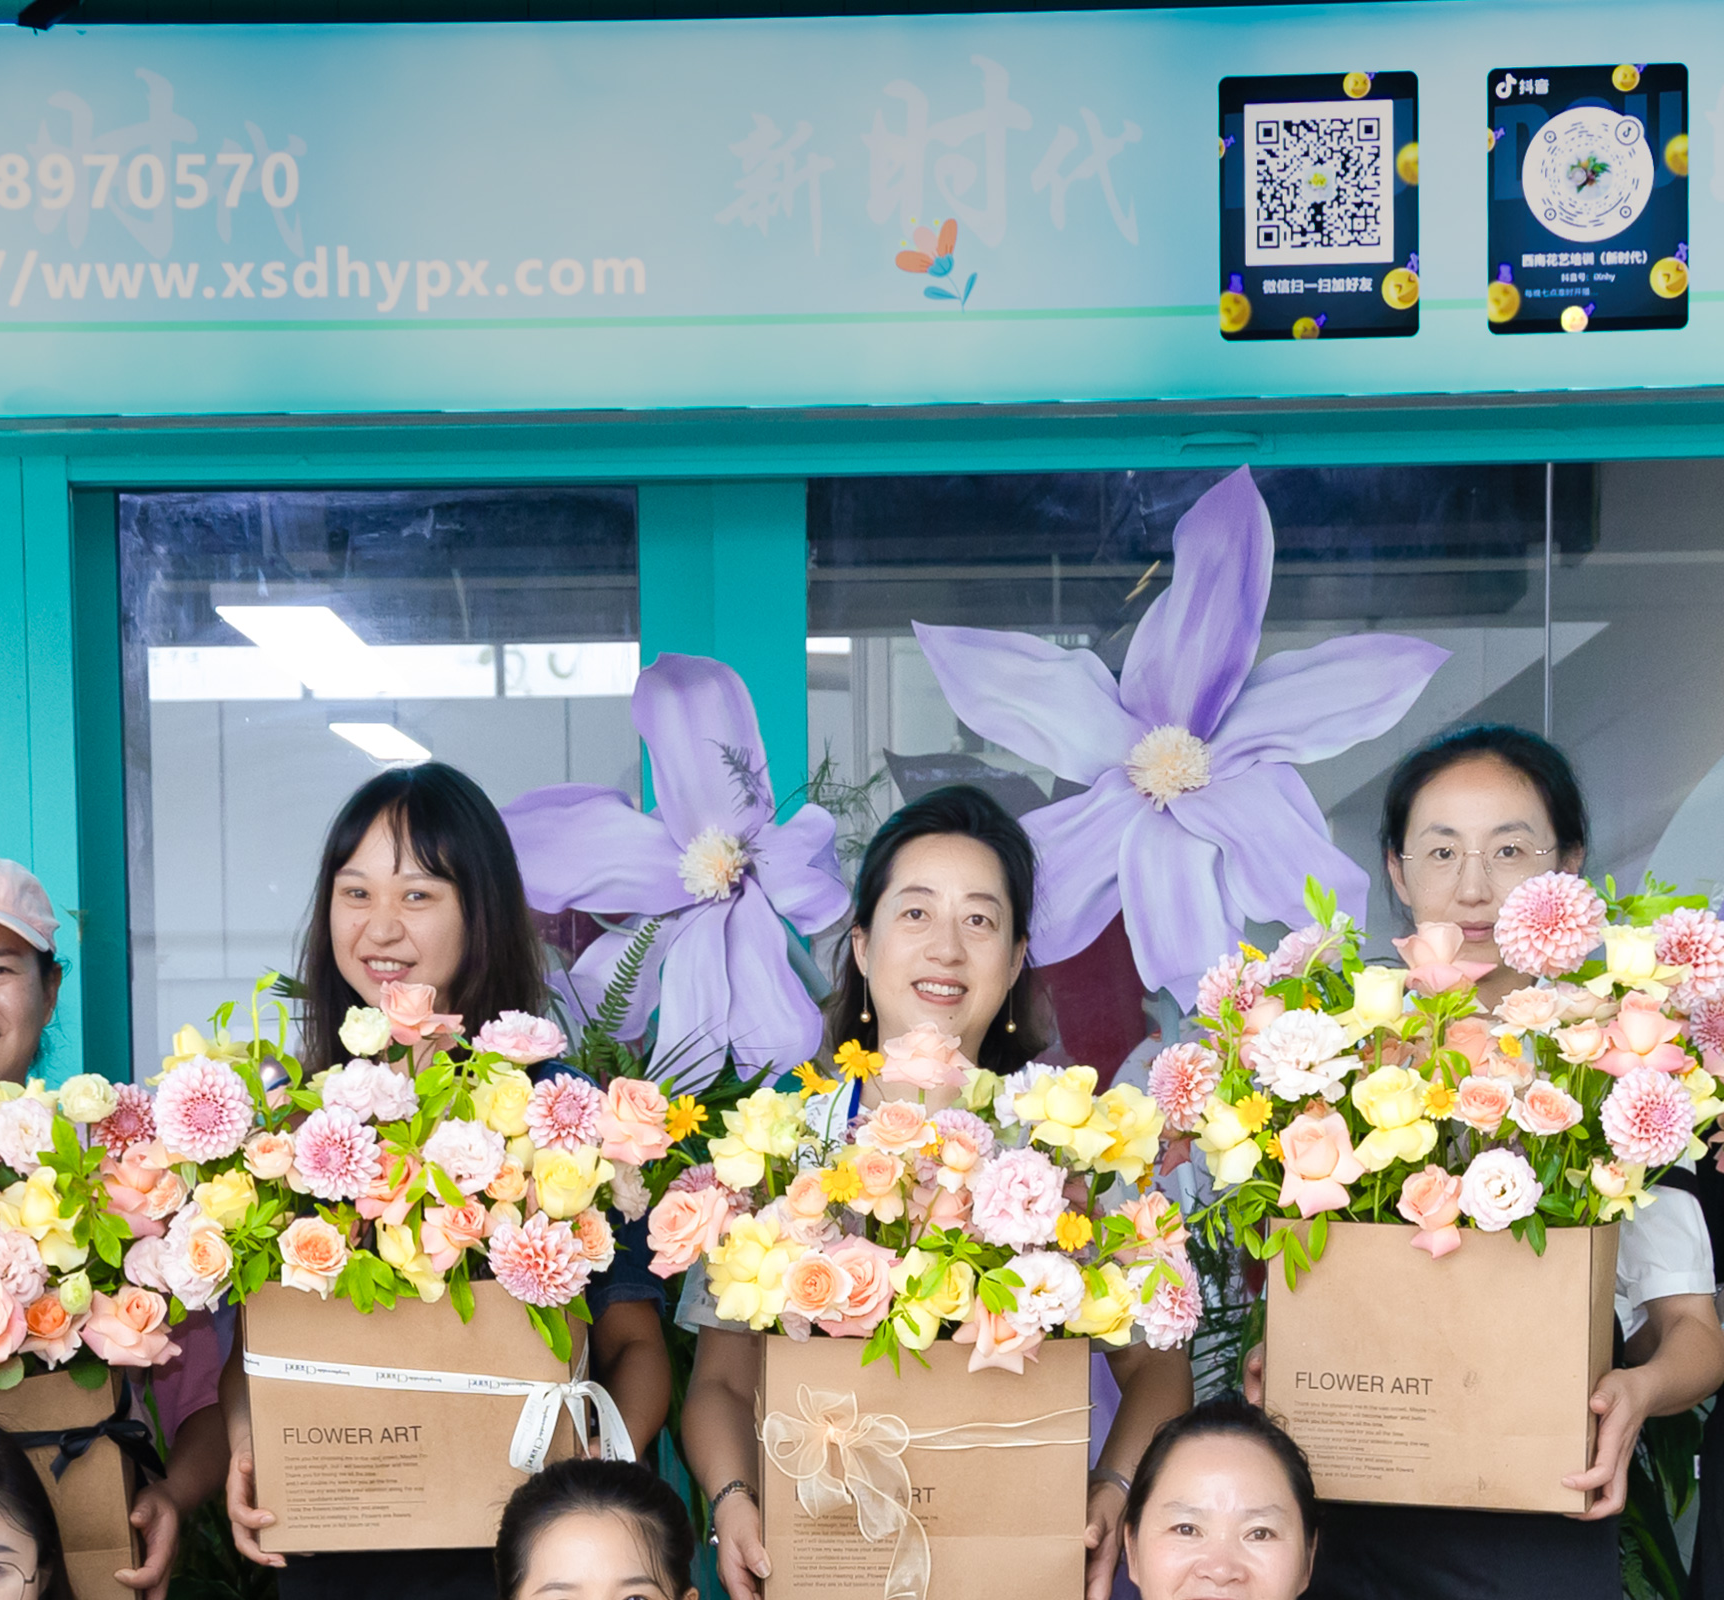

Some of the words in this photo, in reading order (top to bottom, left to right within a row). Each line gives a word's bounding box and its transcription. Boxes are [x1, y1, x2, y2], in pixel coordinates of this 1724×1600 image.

[1519, 78, 1549, 95] 抖音
[1262, 277, 1373, 294] 微信扫一扫加好友
[1296, 1372, 1383, 1393] FLOWER
[1390, 1377, 1433, 1395] ART
[283, 1428, 373, 1444] FLOWER
[380, 1426, 422, 1443] ART
